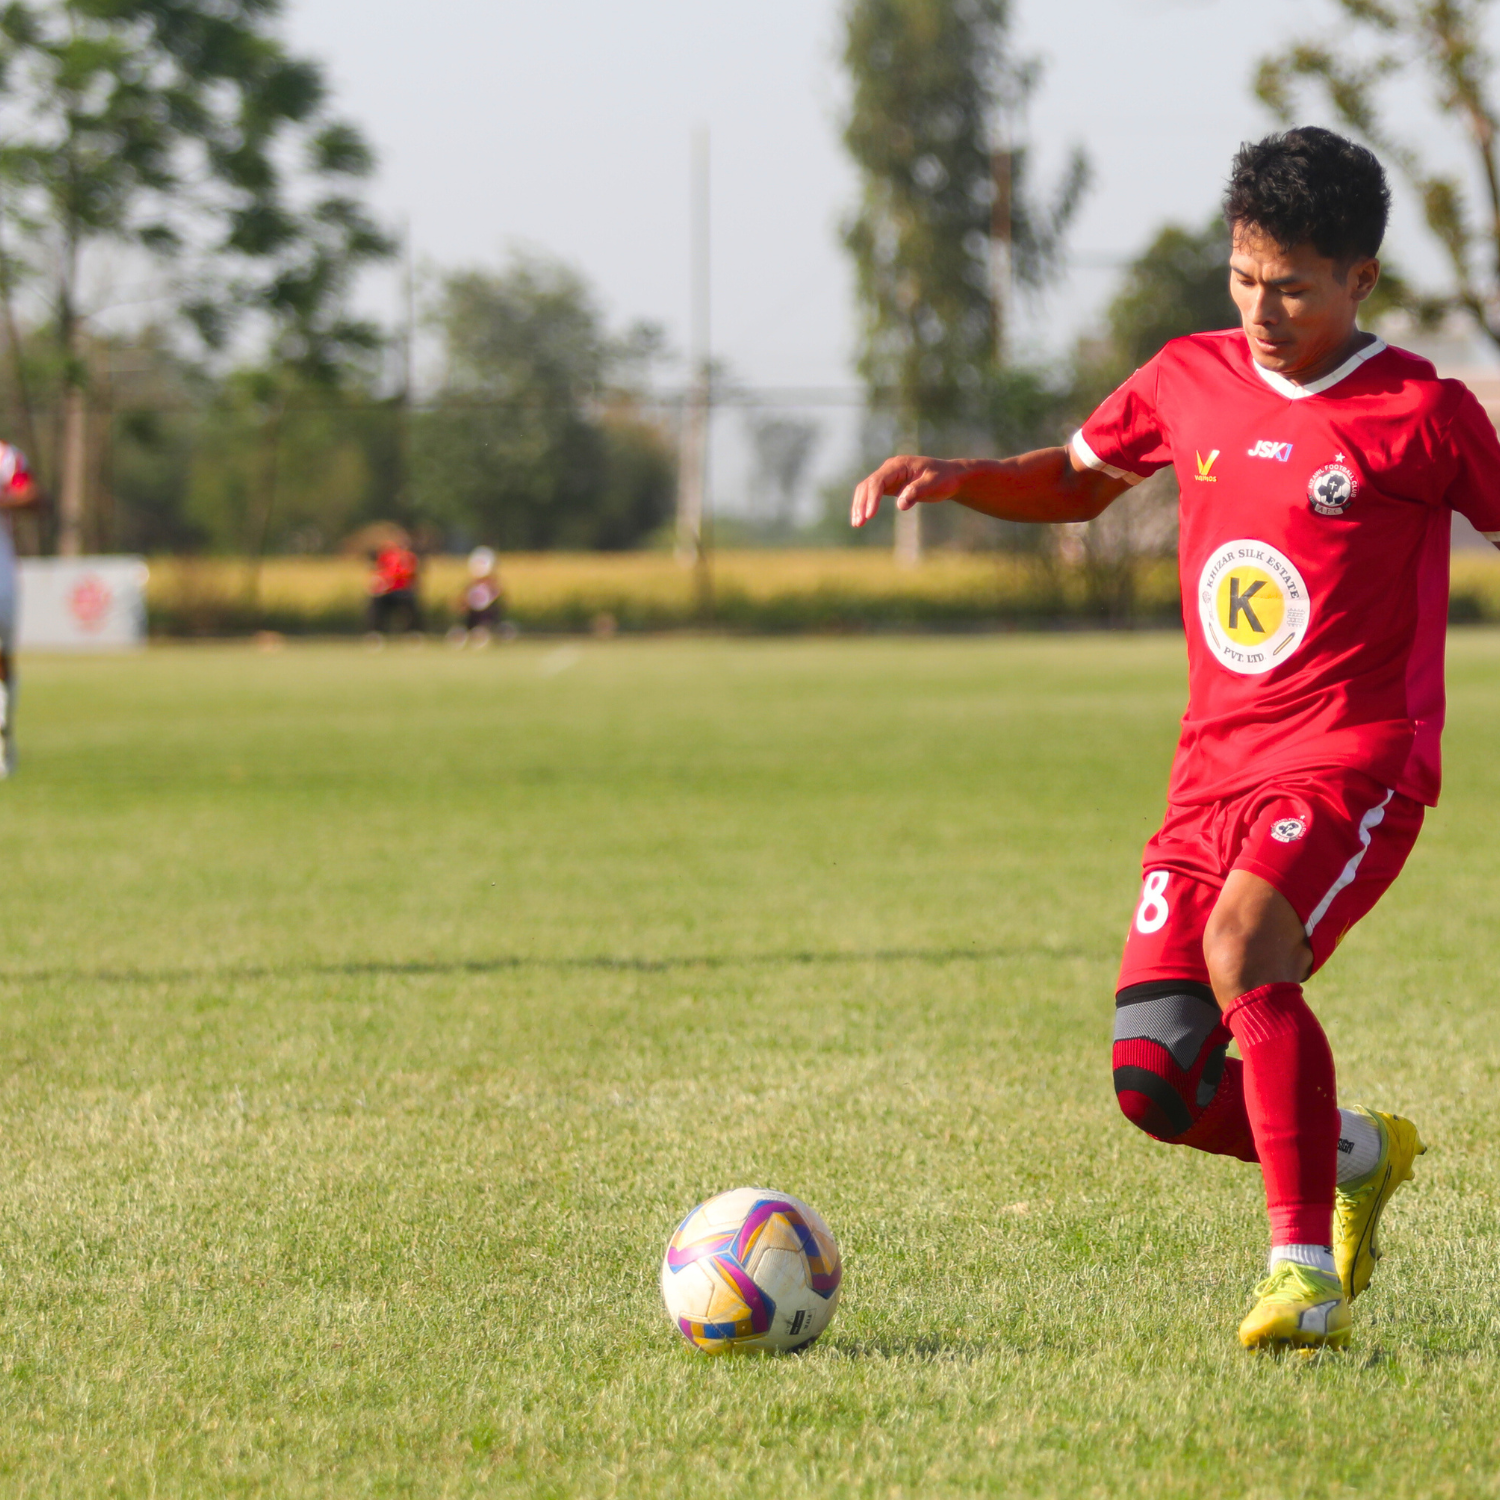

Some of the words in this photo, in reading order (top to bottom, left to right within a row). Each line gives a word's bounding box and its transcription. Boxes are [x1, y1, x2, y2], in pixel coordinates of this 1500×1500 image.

[1308, 468, 1325, 489] AIZAWL
[1324, 464, 1354, 480] FOOTBALL
[1206, 551, 1236, 588] KHIZAR
[1238, 549, 1265, 561] SILK
[1266, 556, 1300, 599] ESTATE
[1228, 577, 1268, 633] K
